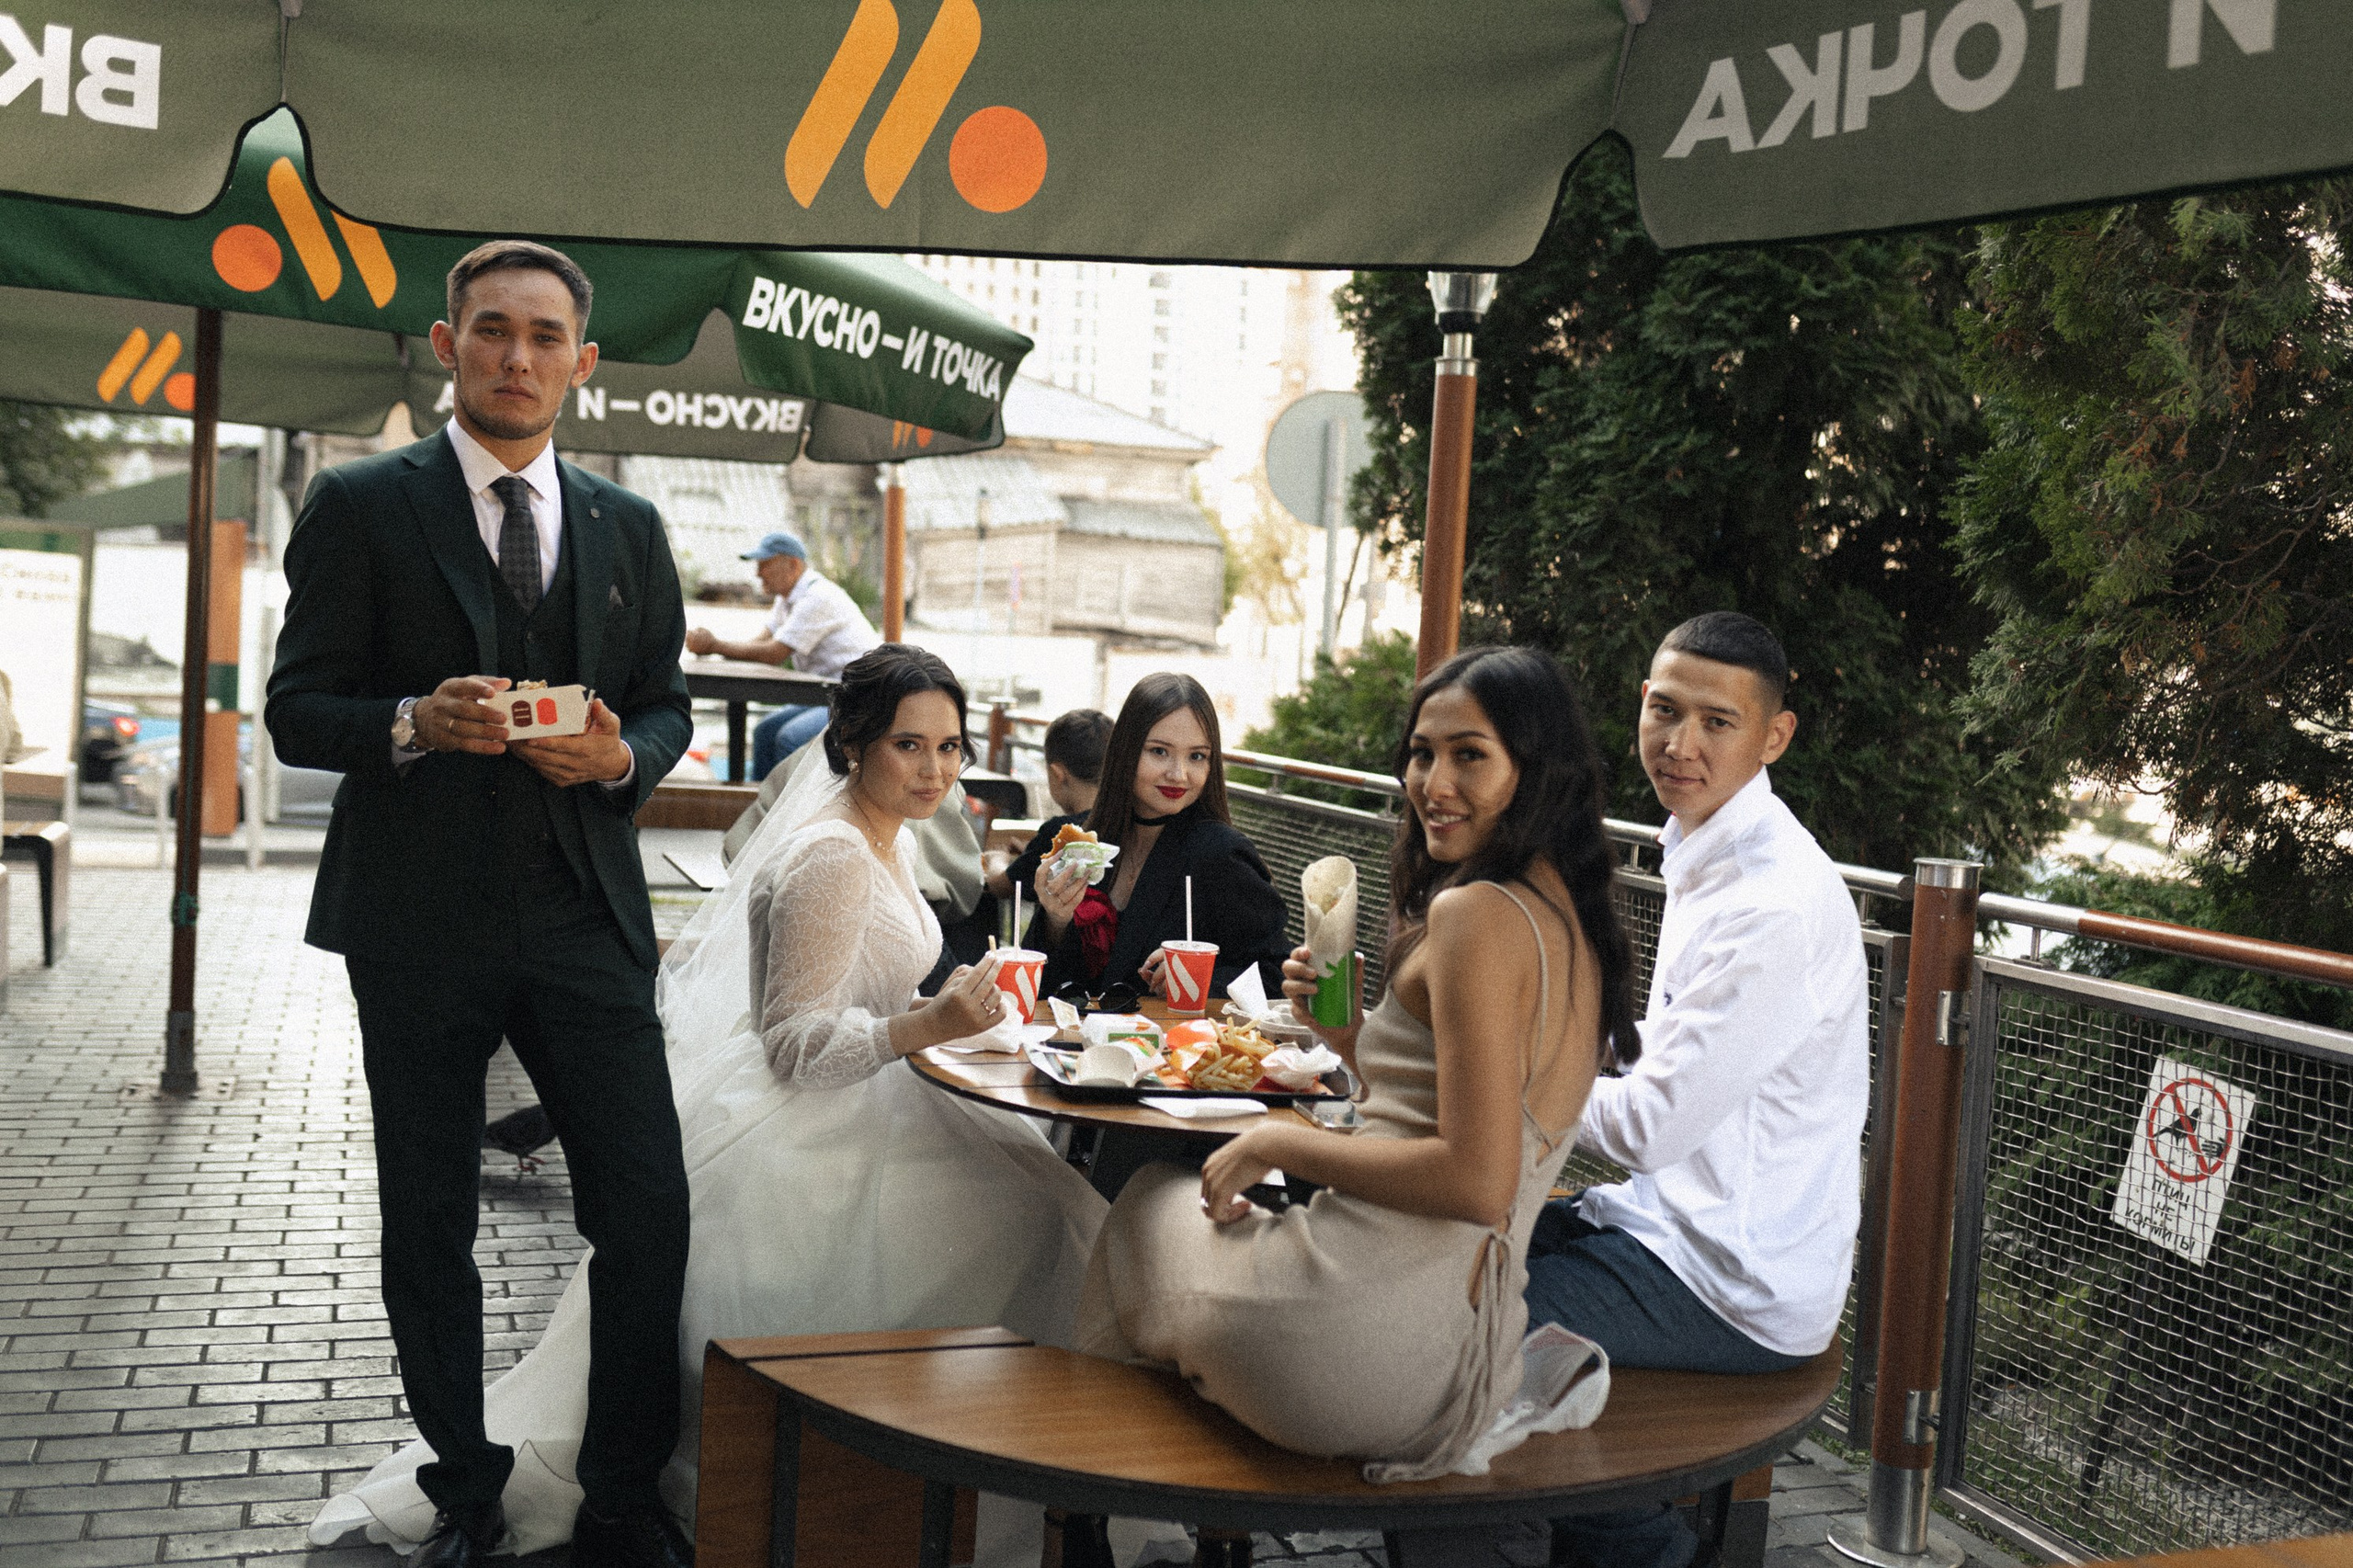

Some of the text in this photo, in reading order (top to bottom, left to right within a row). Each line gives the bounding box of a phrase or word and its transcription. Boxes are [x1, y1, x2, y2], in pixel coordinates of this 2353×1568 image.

[930, 335, 1005, 402] ТОЧКА
[2152, 1178, 2190, 1210] ПТИЦ
[2155, 1201, 2176, 1221] НЕ
